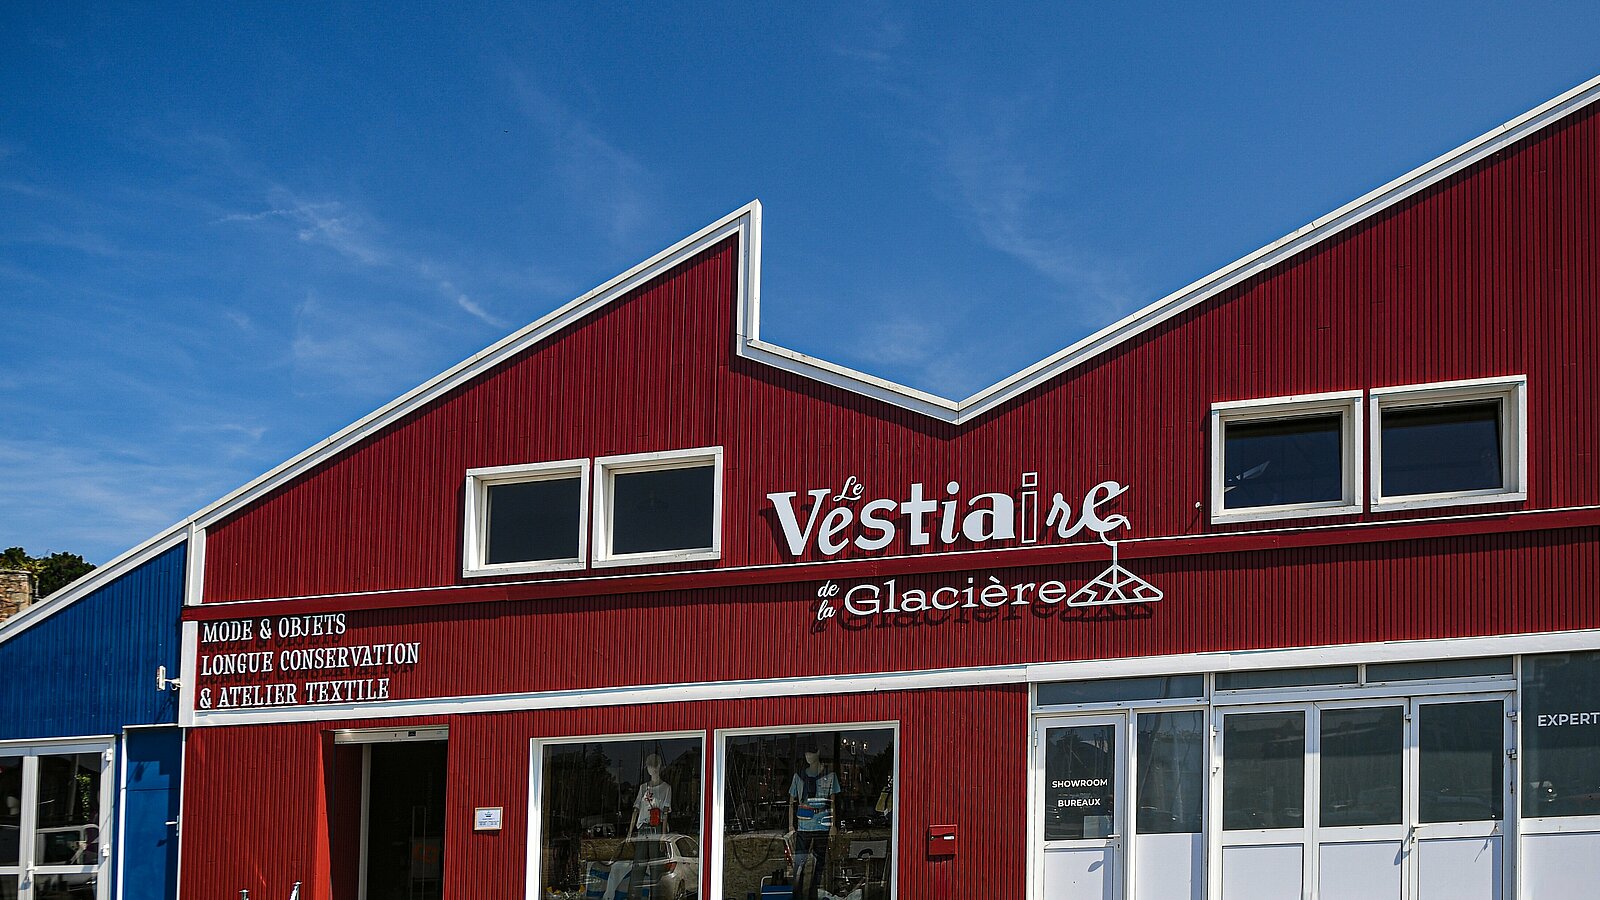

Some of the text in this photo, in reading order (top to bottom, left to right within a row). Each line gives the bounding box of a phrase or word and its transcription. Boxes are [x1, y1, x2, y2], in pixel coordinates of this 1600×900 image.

[833, 475, 864, 502] Le
[766, 471, 1131, 556] Vestiaire
[817, 580, 840, 598] de
[844, 575, 1067, 616] Glacière
[817, 599, 837, 621] la
[201, 613, 346, 643] MODE & OBJETS
[201, 642, 421, 676] LONGUE CONSERVATION
[199, 677, 390, 709] & ATELIER TEXTILE
[1537, 712, 1600, 727] EXPERT
[1051, 778, 1108, 789] SHOWROOM
[1057, 798, 1101, 808] BUREAUX
